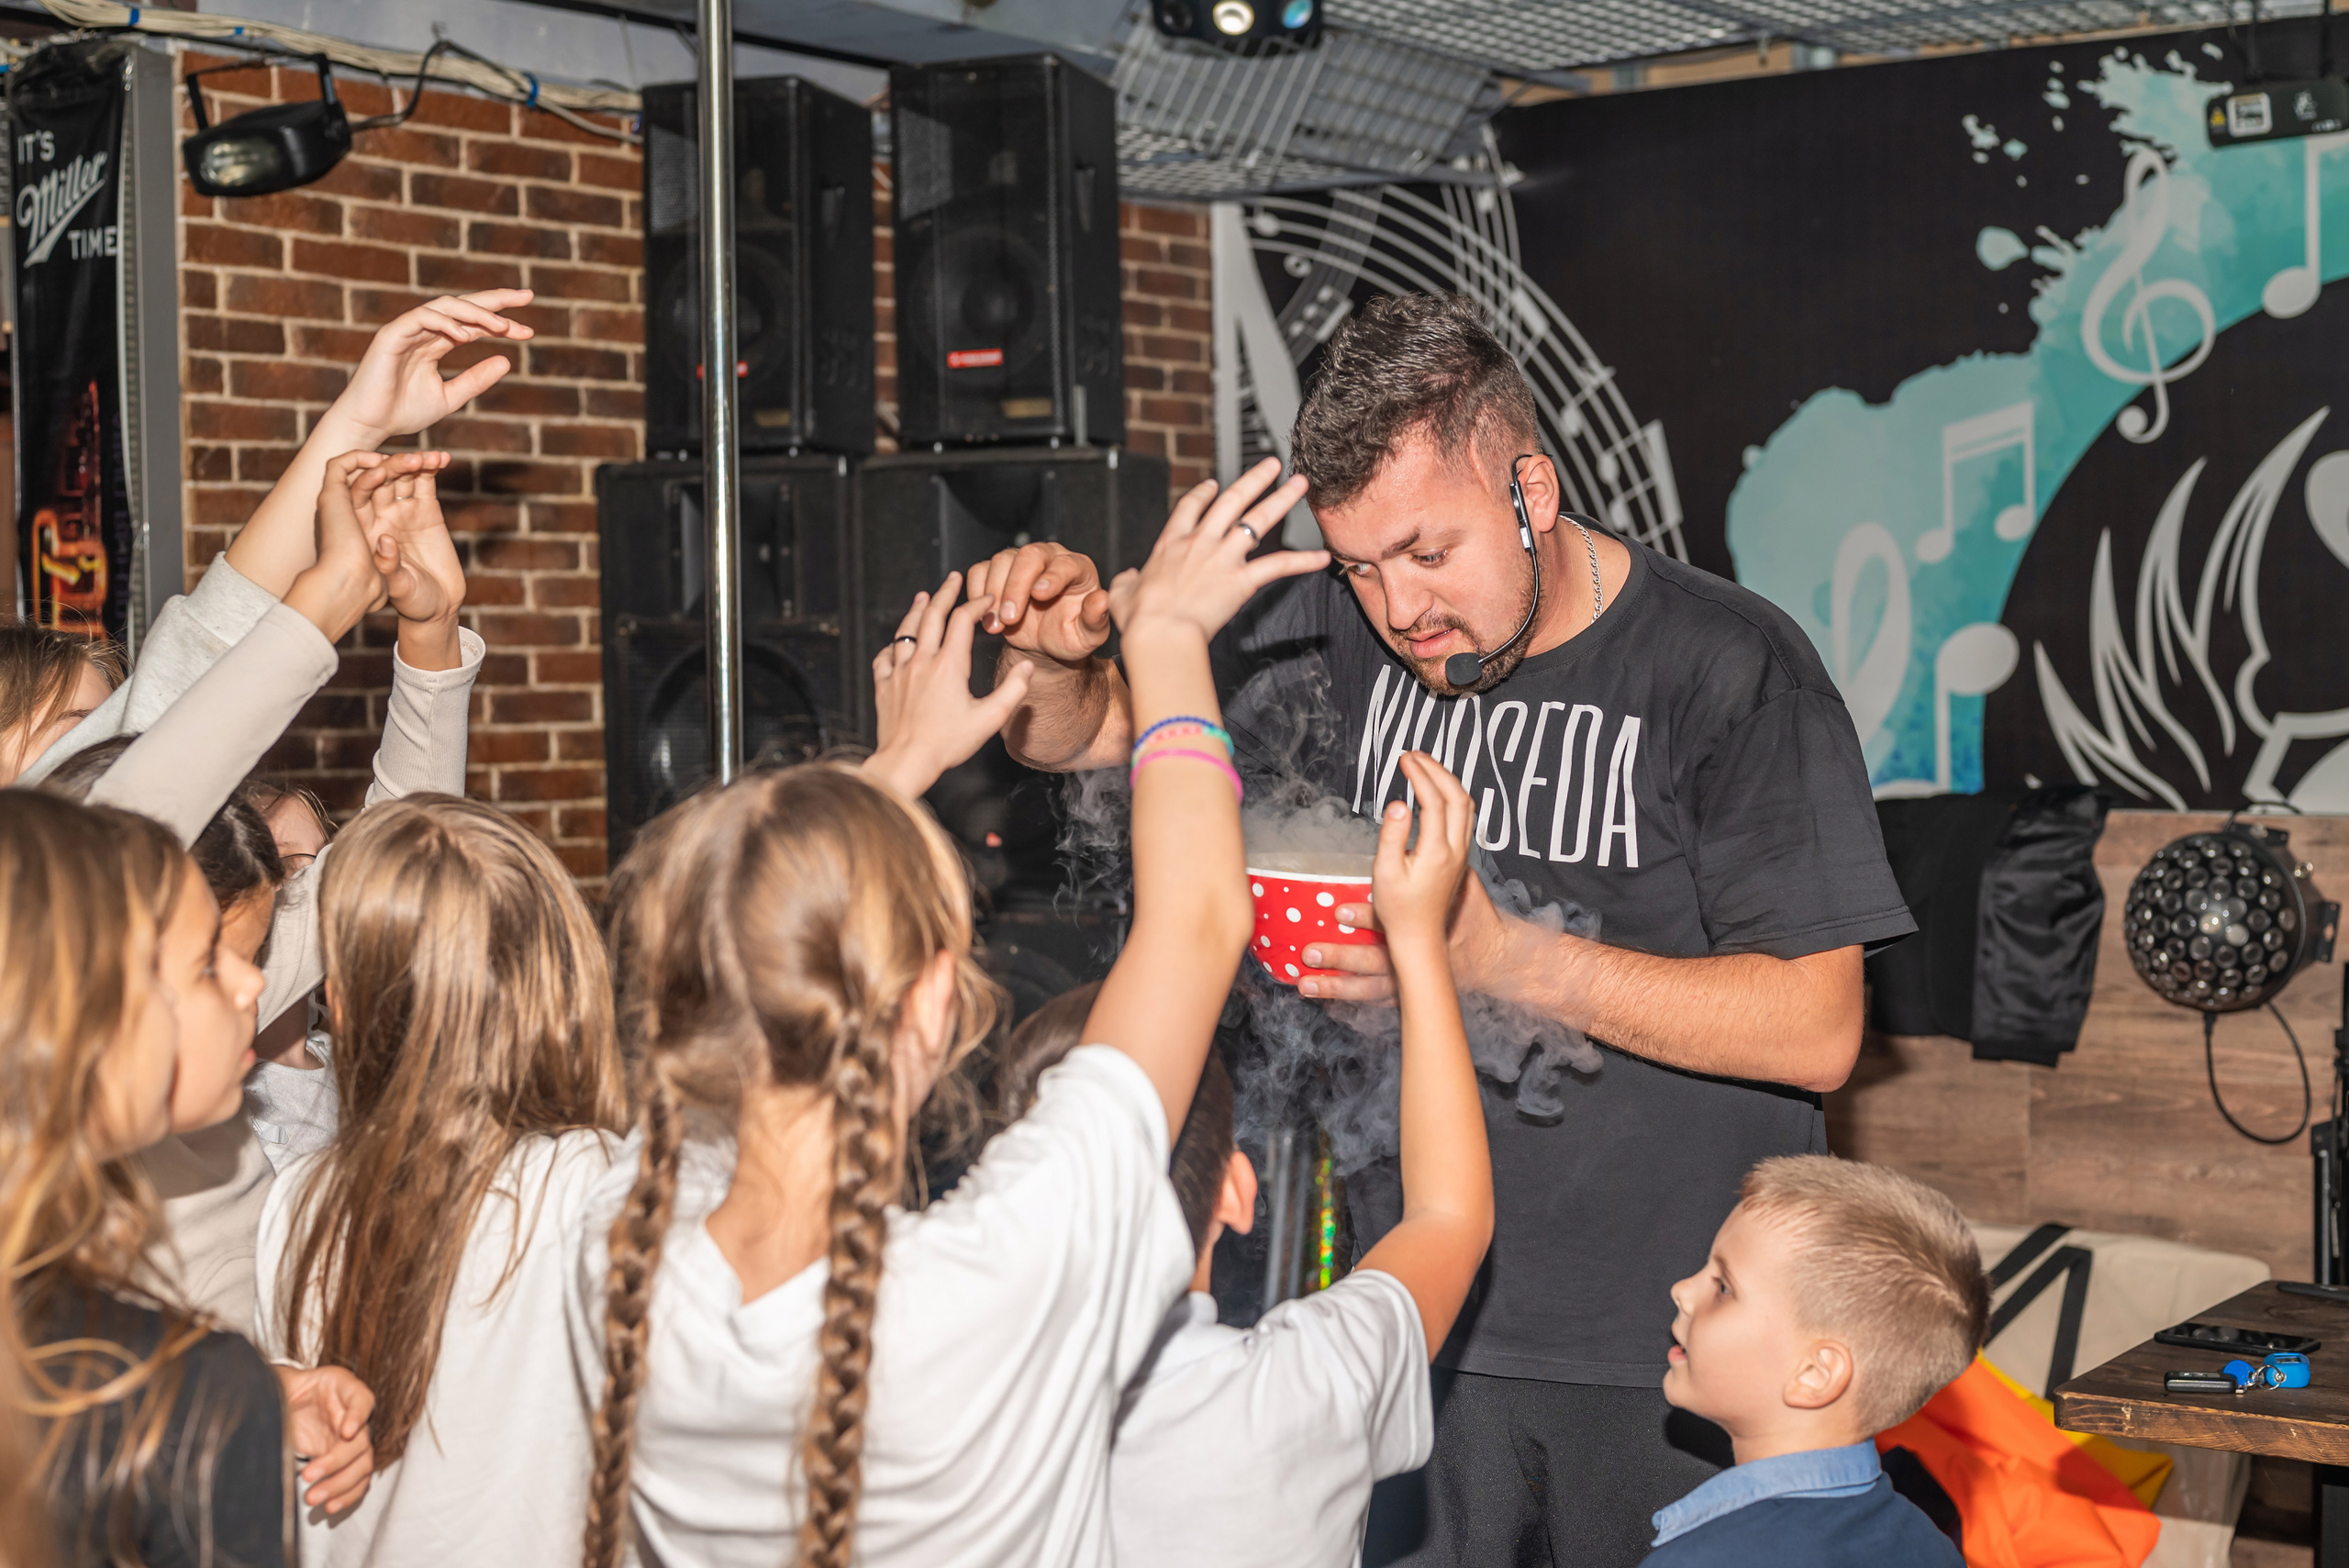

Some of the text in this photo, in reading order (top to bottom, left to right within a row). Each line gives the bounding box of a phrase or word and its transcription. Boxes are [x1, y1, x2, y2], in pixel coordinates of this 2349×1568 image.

[17, 129, 56, 165] IT'S
[16, 150, 109, 262] Miller
[67, 225, 117, 261] TIME
